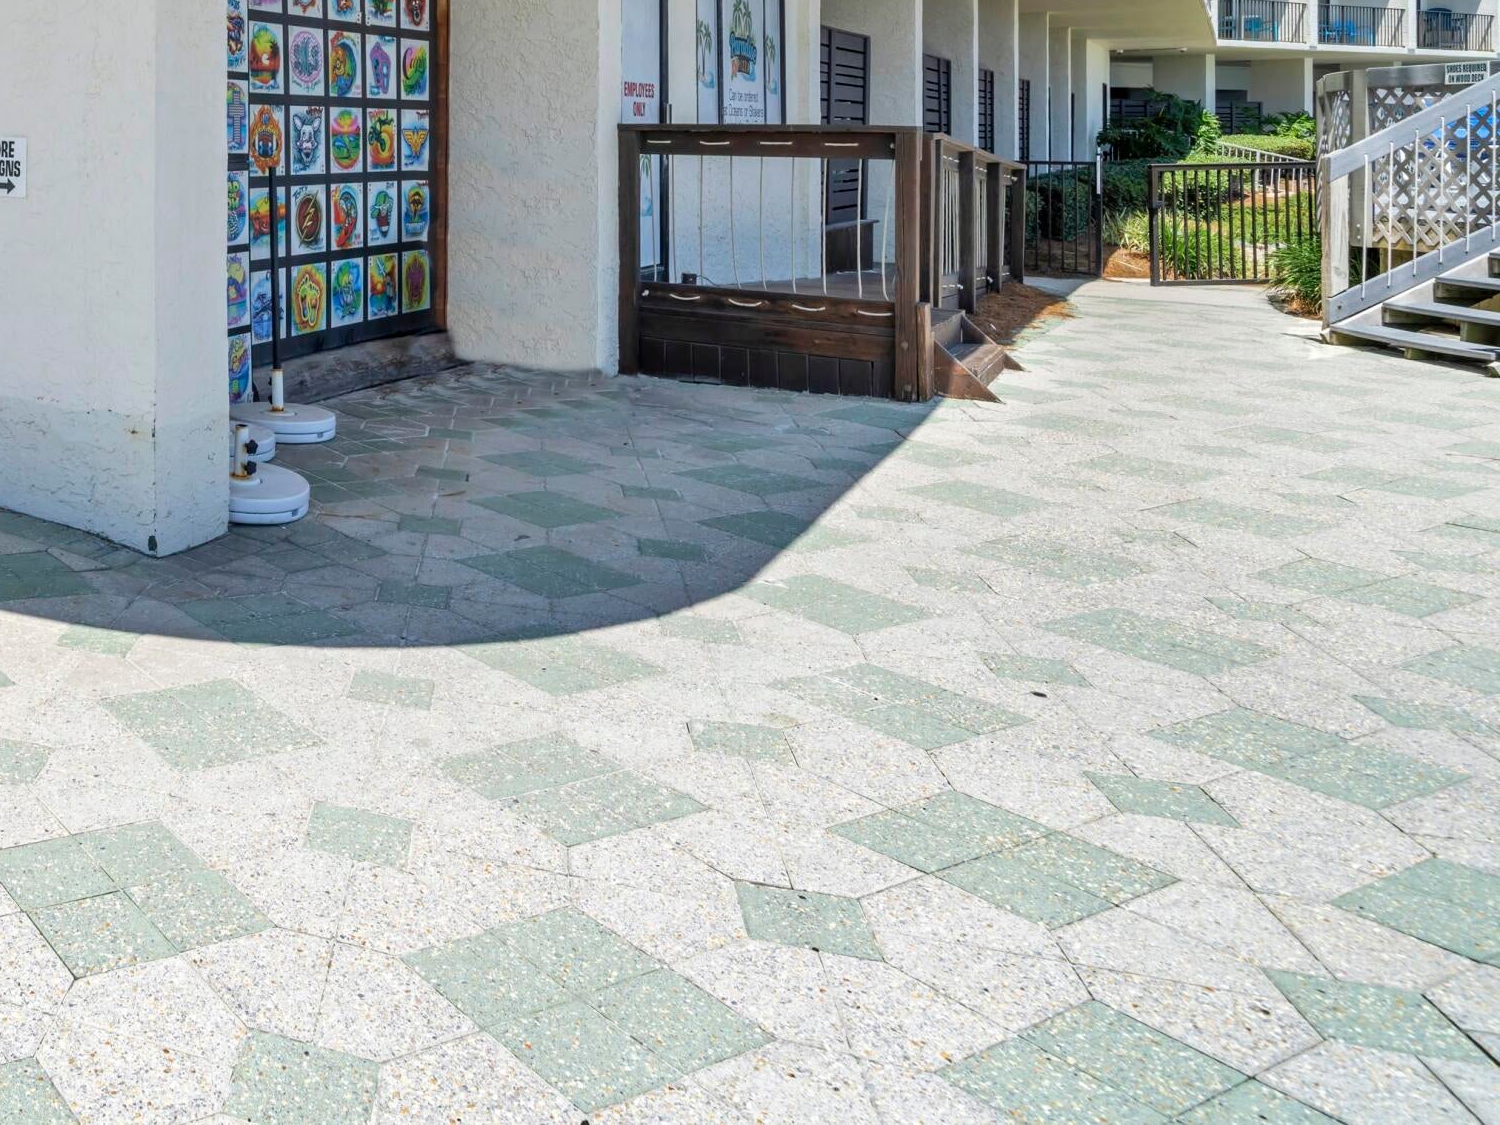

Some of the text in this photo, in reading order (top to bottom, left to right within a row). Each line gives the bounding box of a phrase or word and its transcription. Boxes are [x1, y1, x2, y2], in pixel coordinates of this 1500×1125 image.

[1446, 63, 1487, 74] SHOES REQUIRED
[1456, 74, 1470, 83] WOOD
[624, 81, 655, 98] EMPLOYEES
[633, 101, 646, 116] ONLY
